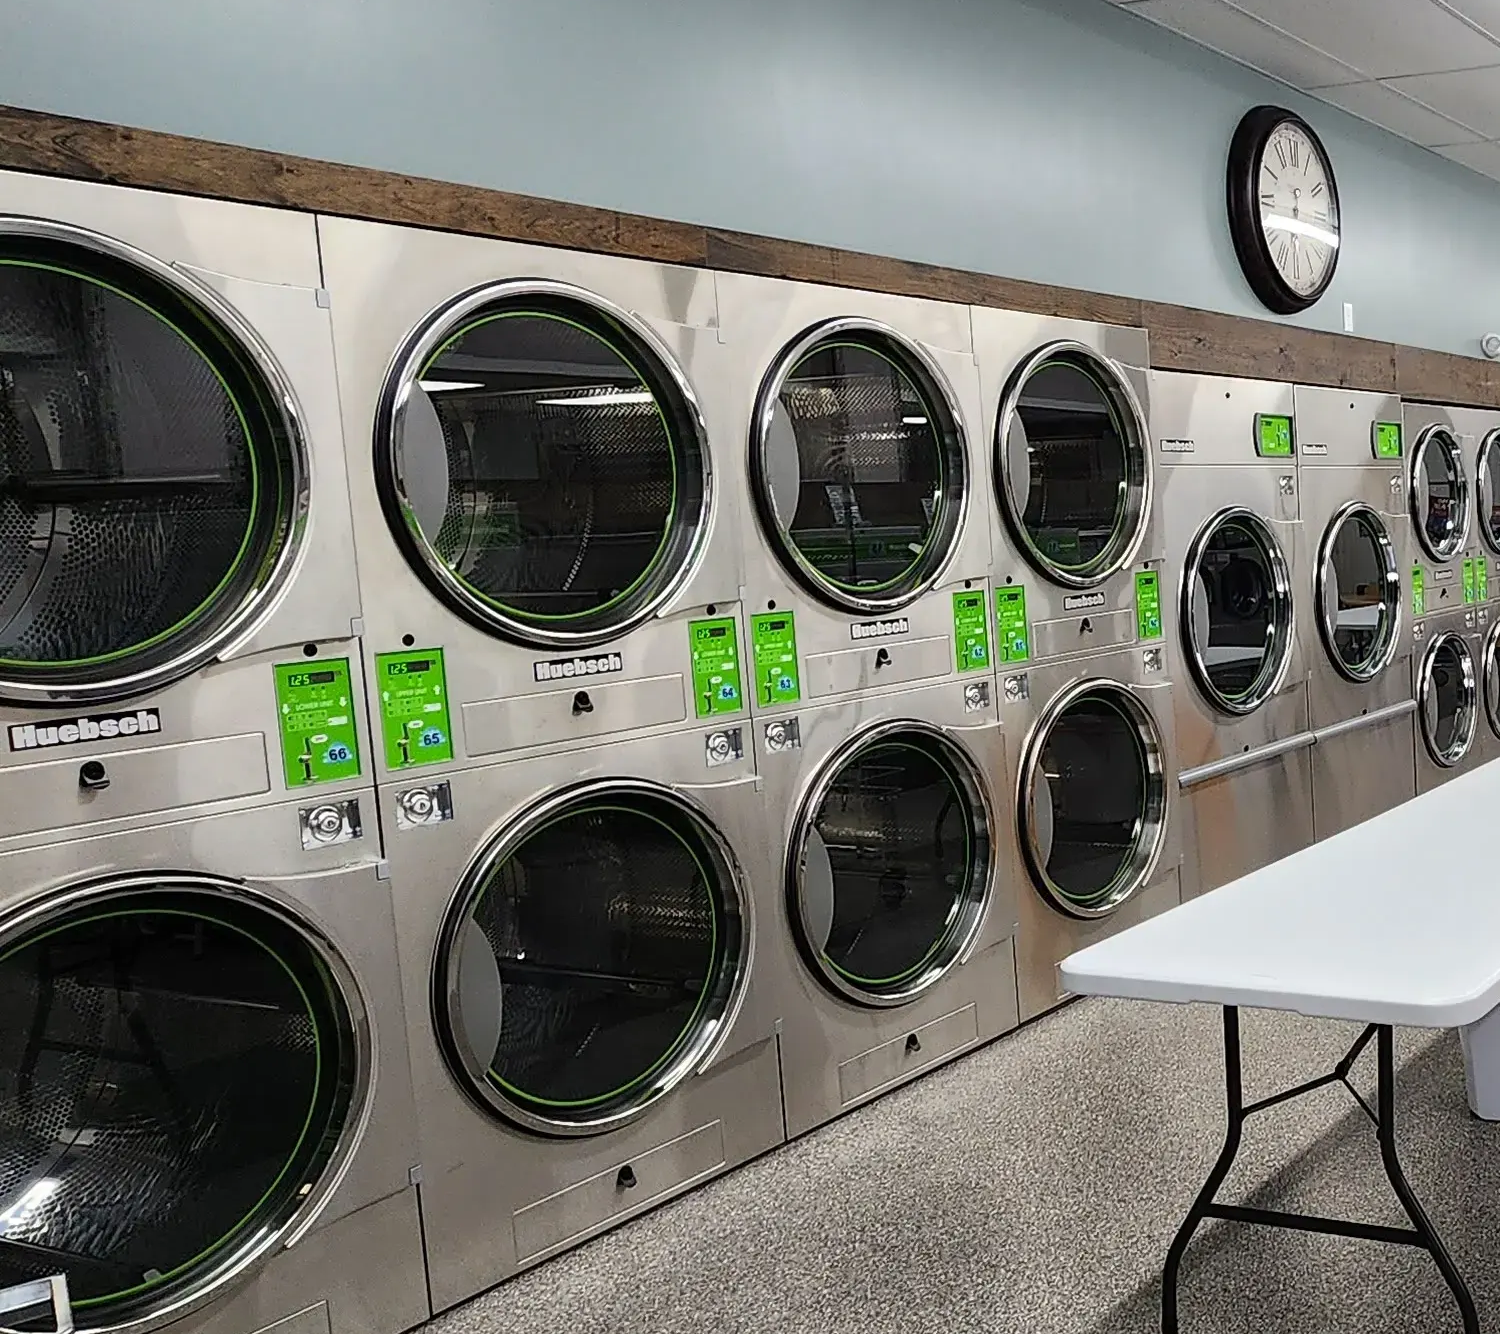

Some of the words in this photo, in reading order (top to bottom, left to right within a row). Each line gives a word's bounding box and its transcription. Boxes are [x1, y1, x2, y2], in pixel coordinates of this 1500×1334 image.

[852, 618, 908, 639] Huebsch
[536, 654, 621, 681] Huebsch
[780, 678, 791, 689] 63
[722, 687, 734, 698] 64
[11, 710, 159, 749] Huebsch
[423, 733, 440, 746] 65
[328, 747, 347, 761] 66
